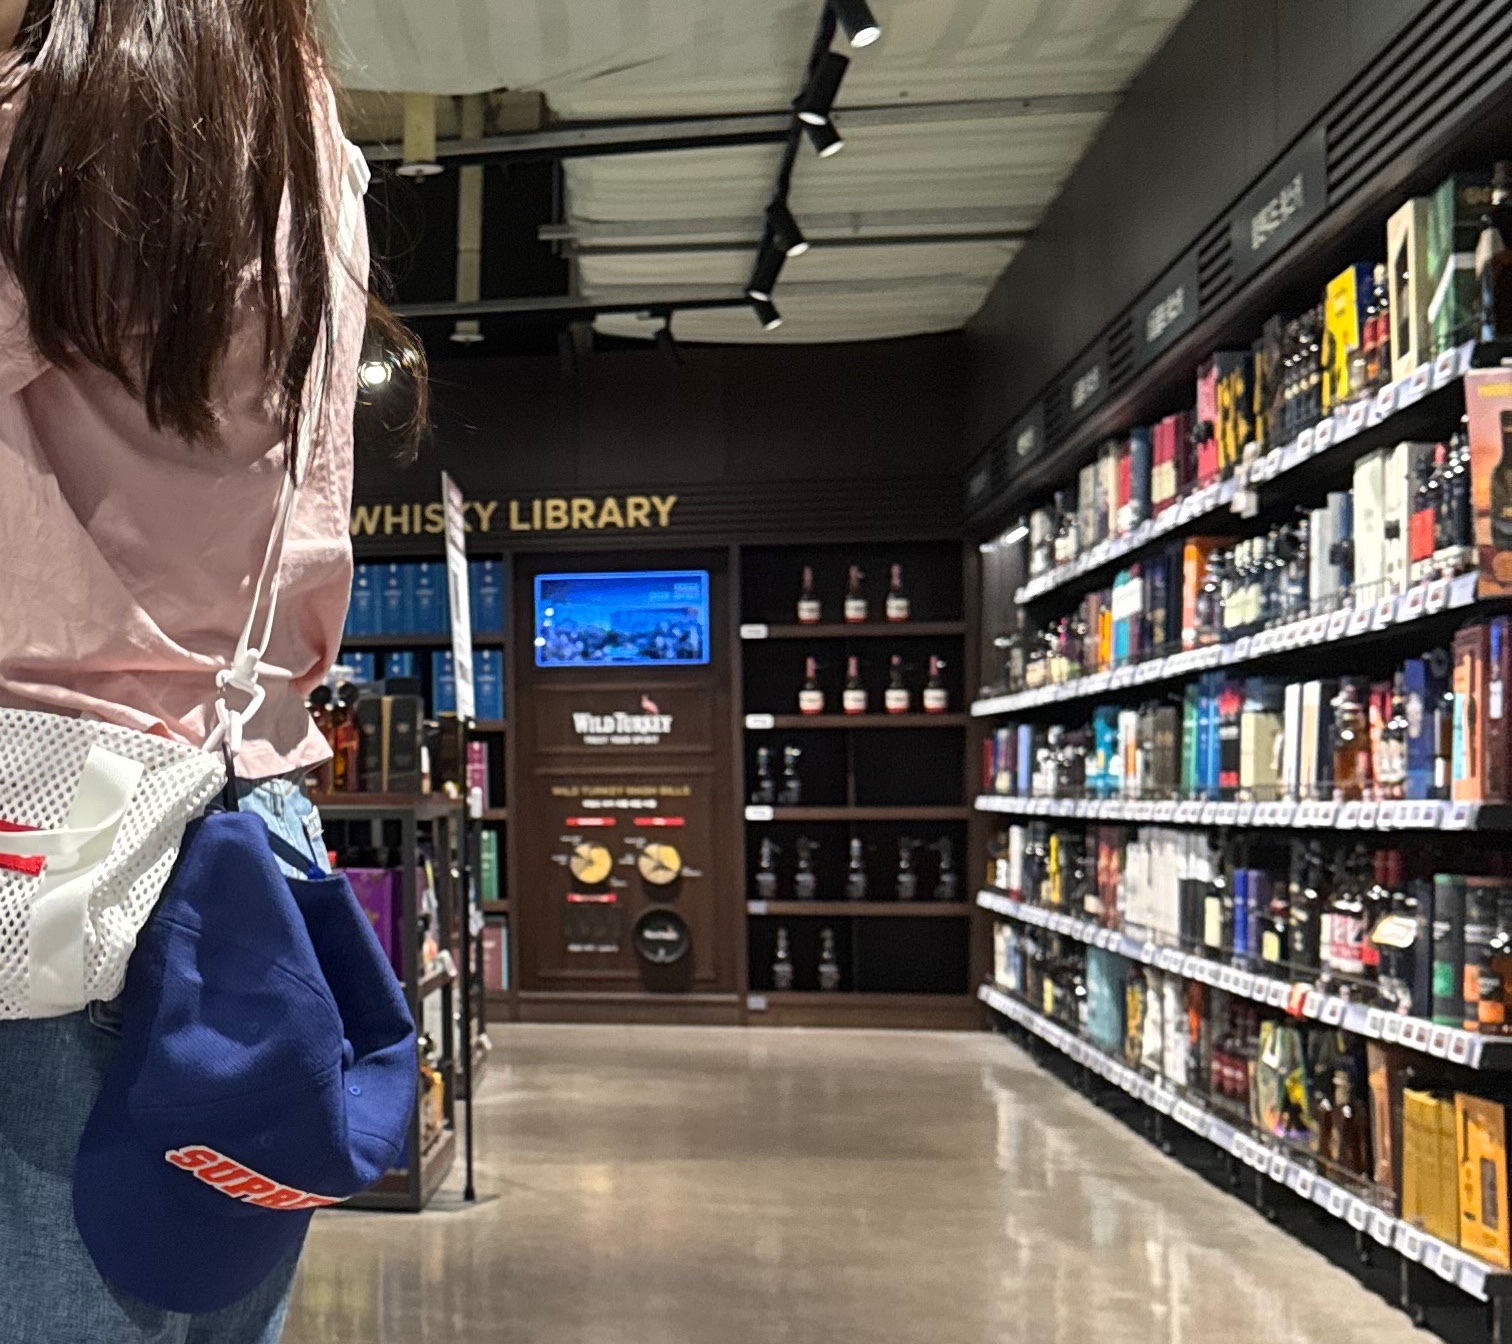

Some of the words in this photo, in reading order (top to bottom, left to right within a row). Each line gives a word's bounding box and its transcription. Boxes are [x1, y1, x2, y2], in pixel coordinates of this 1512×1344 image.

[350, 500, 500, 537] WHISKY
[509, 494, 679, 532] LIBRARY
[572, 711, 614, 734] WILD
